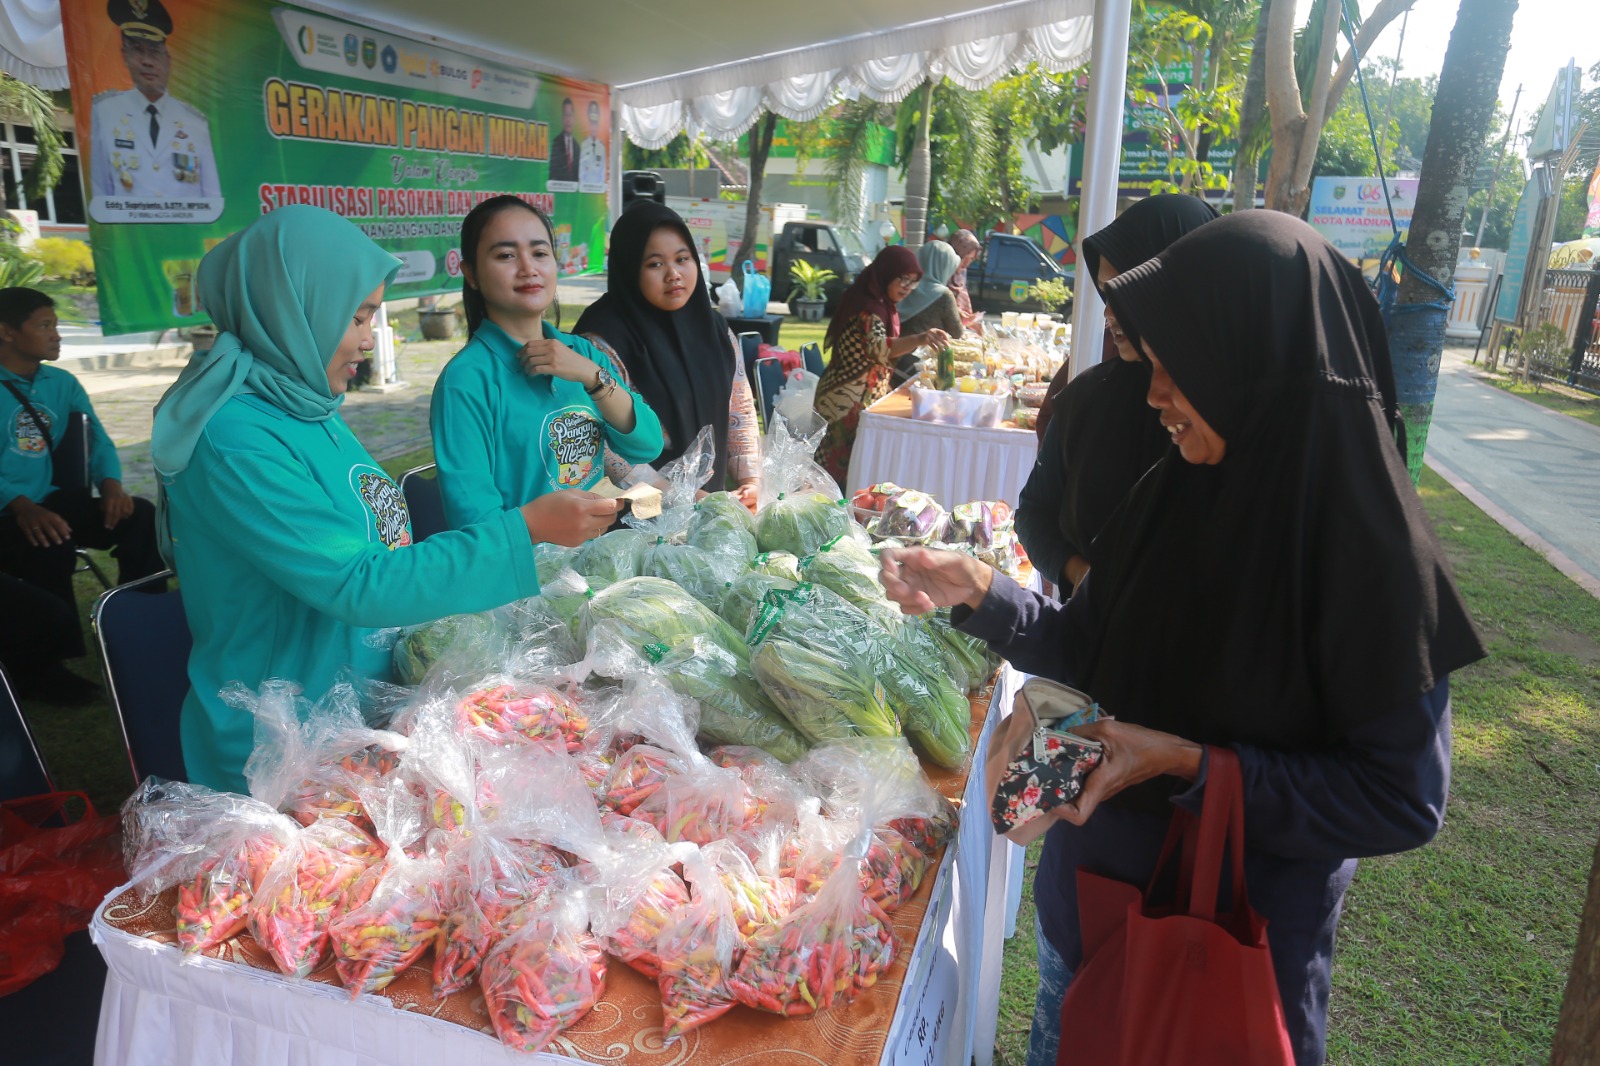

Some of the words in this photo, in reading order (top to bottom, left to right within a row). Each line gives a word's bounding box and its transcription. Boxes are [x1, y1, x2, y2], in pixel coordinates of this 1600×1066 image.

[440, 65, 468, 80] BULOG
[264, 78, 398, 148] GERAKAN
[402, 100, 486, 156] PANGAN
[488, 114, 549, 162] MURAH
[105, 200, 122, 210] Eddy
[260, 184, 374, 217] STABILISASI
[377, 187, 444, 217] PASOKAN
[447, 190, 473, 216] DAN
[1314, 205, 1364, 216] SELAMAT
[1313, 215, 1343, 226] KOTA
[1345, 216, 1391, 228] MADIUN
[388, 222, 432, 237] PANGAN
[432, 222, 454, 236] DAN
[554, 421, 600, 446] Pangan
